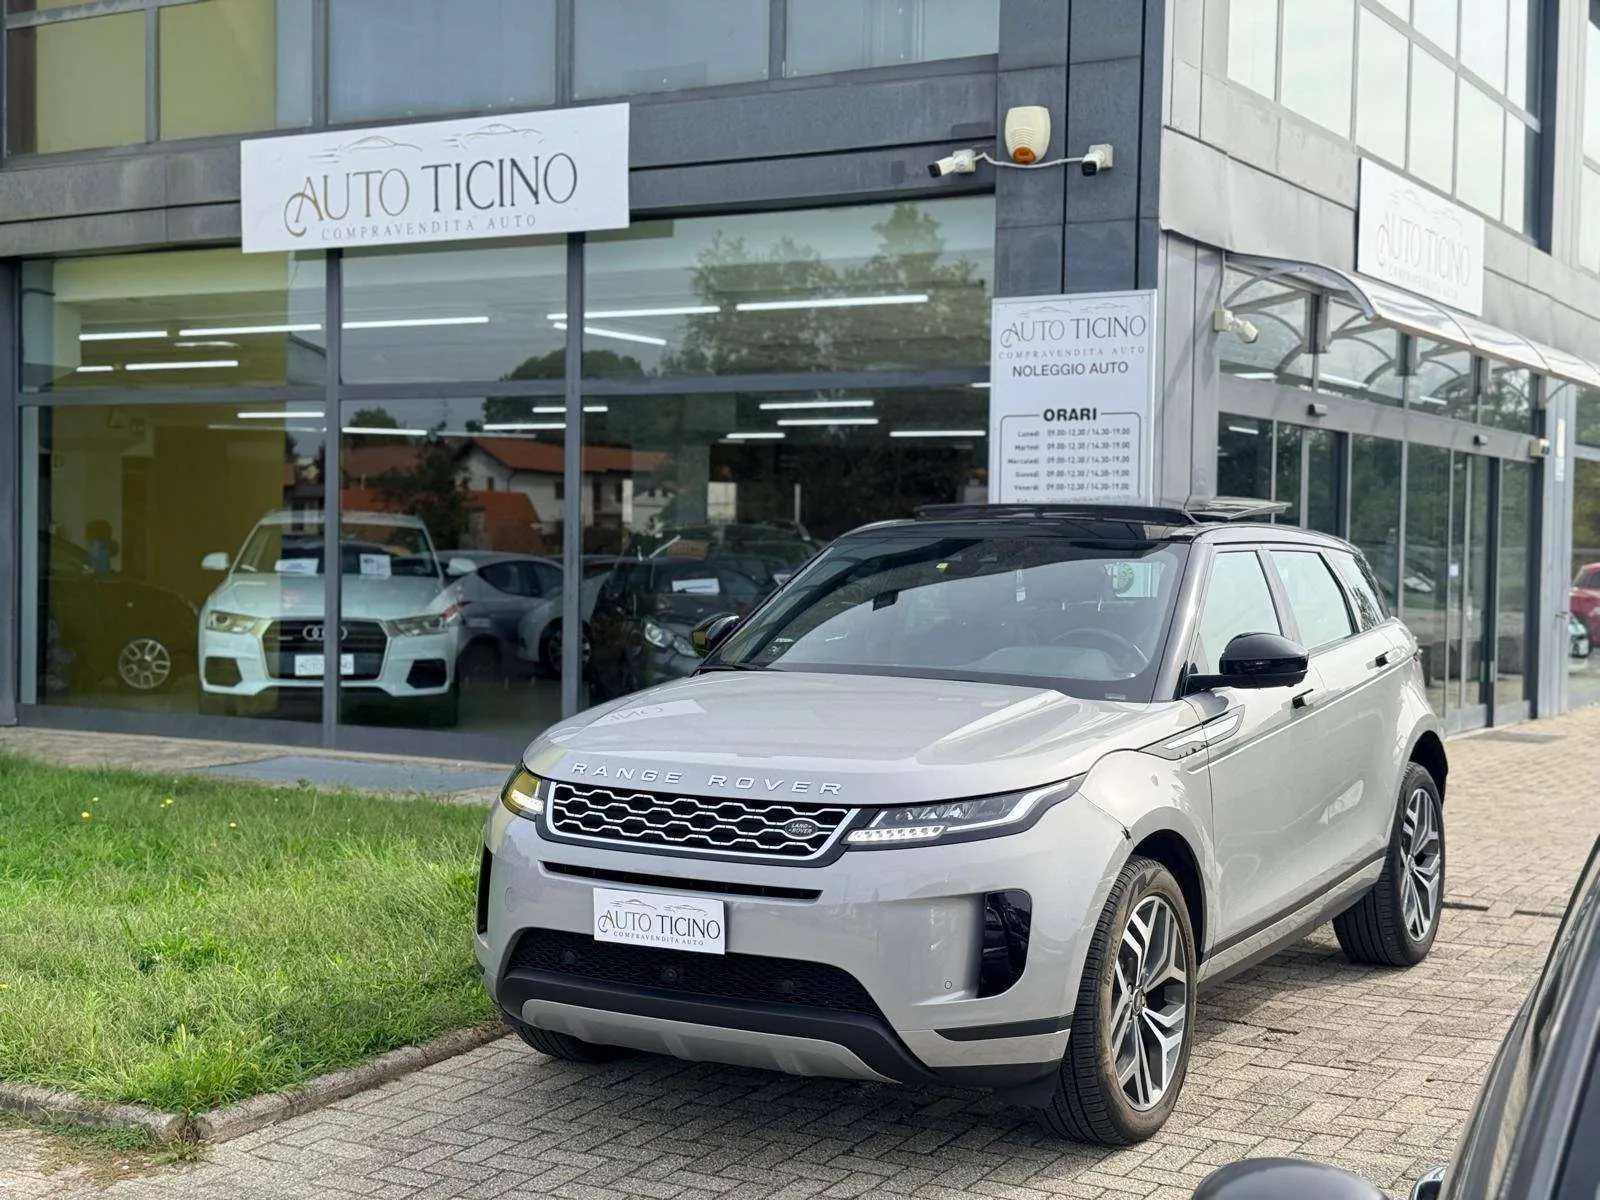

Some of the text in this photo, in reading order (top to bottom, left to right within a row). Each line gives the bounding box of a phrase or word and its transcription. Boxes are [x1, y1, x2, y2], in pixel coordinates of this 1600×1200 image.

[284, 153, 578, 237] AUTO TICINO
[321, 214, 537, 241] COMPRAVENDITA AUTO
[1377, 209, 1422, 268] AUTO
[1000, 315, 1146, 348] AUTO TICINO
[998, 346, 1145, 359] COMPRAVENDITA AUTO
[1012, 361, 1129, 378] NOLEGGIO AUTO
[1043, 408, 1097, 422] ORARI
[571, 762, 843, 795] RANGE ROVER
[598, 910, 721, 940] AUTO TICINO
[613, 931, 679, 944] COMPRAVENDITA
